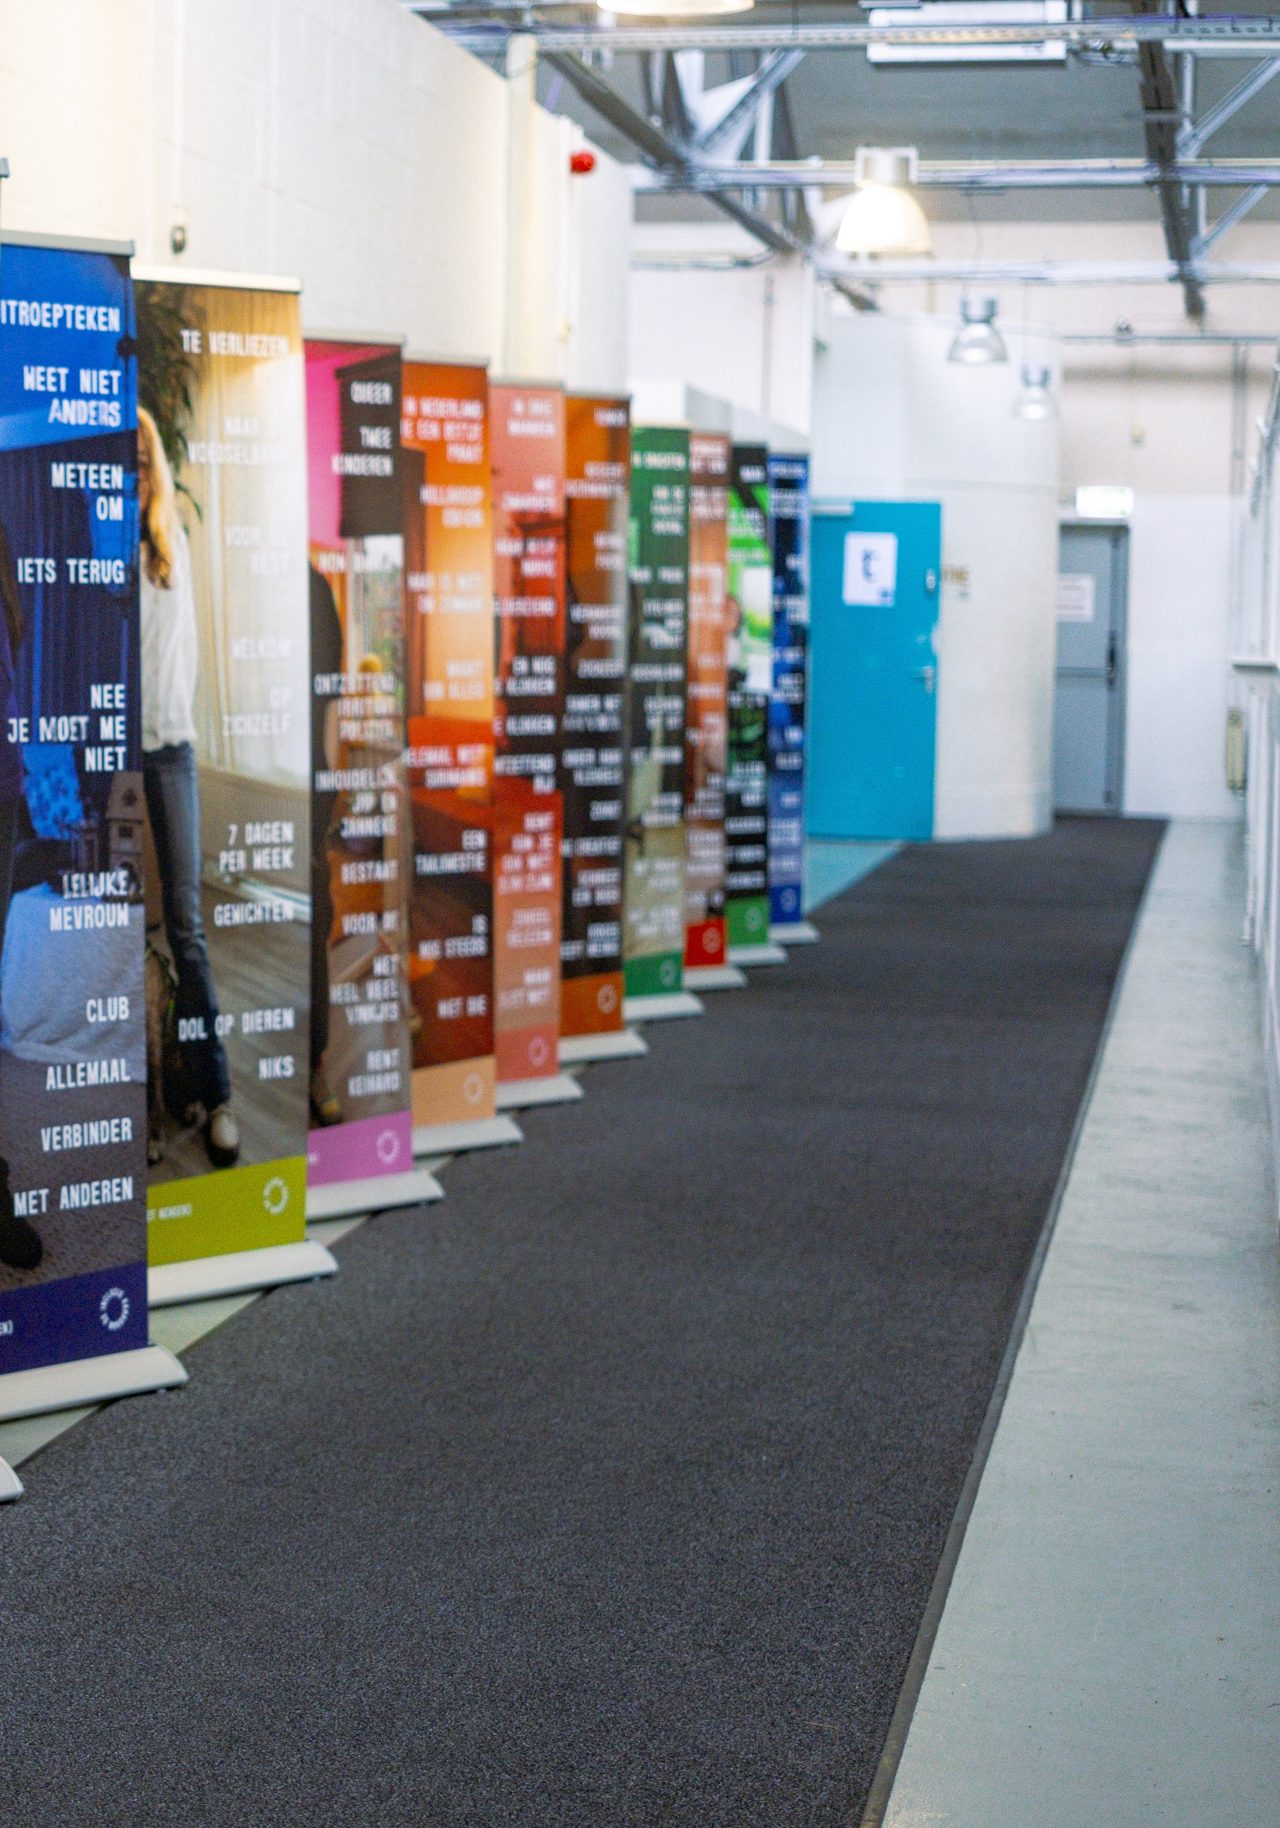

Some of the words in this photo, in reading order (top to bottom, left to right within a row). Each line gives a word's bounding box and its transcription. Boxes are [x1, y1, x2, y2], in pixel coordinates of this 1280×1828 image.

[180, 328, 202, 354] TE
[23, 365, 68, 393] WEET
[80, 368, 121, 395] NIET
[48, 399, 121, 428] ANDERS
[51, 462, 123, 490] METEEN
[96, 495, 123, 521] OM
[18, 557, 56, 584] IETS
[68, 558, 125, 584] TERUG
[90, 683, 126, 711] NEE
[7, 717, 29, 744] JE
[39, 715, 89, 743] MOET
[100, 715, 126, 741] ME
[84, 746, 127, 773] NIET
[228, 822, 236, 846] 7
[245, 820, 294, 845] DAGEN
[220, 848, 247, 872] PER
[253, 846, 294, 870] WEEK
[50, 903, 129, 932] MEVROUW
[213, 900, 295, 929] GEWICHTEN
[86, 997, 130, 1023] CLUB
[178, 1016, 207, 1043] DOL
[214, 1012, 235, 1038] OP
[242, 1007, 295, 1036] DIEREN
[46, 1058, 131, 1092] ALLEMAAL
[259, 1055, 294, 1081] NIKS
[41, 1117, 132, 1153] VERBINDER
[13, 1187, 48, 1218] MET
[59, 1176, 133, 1210] ANDEREN
